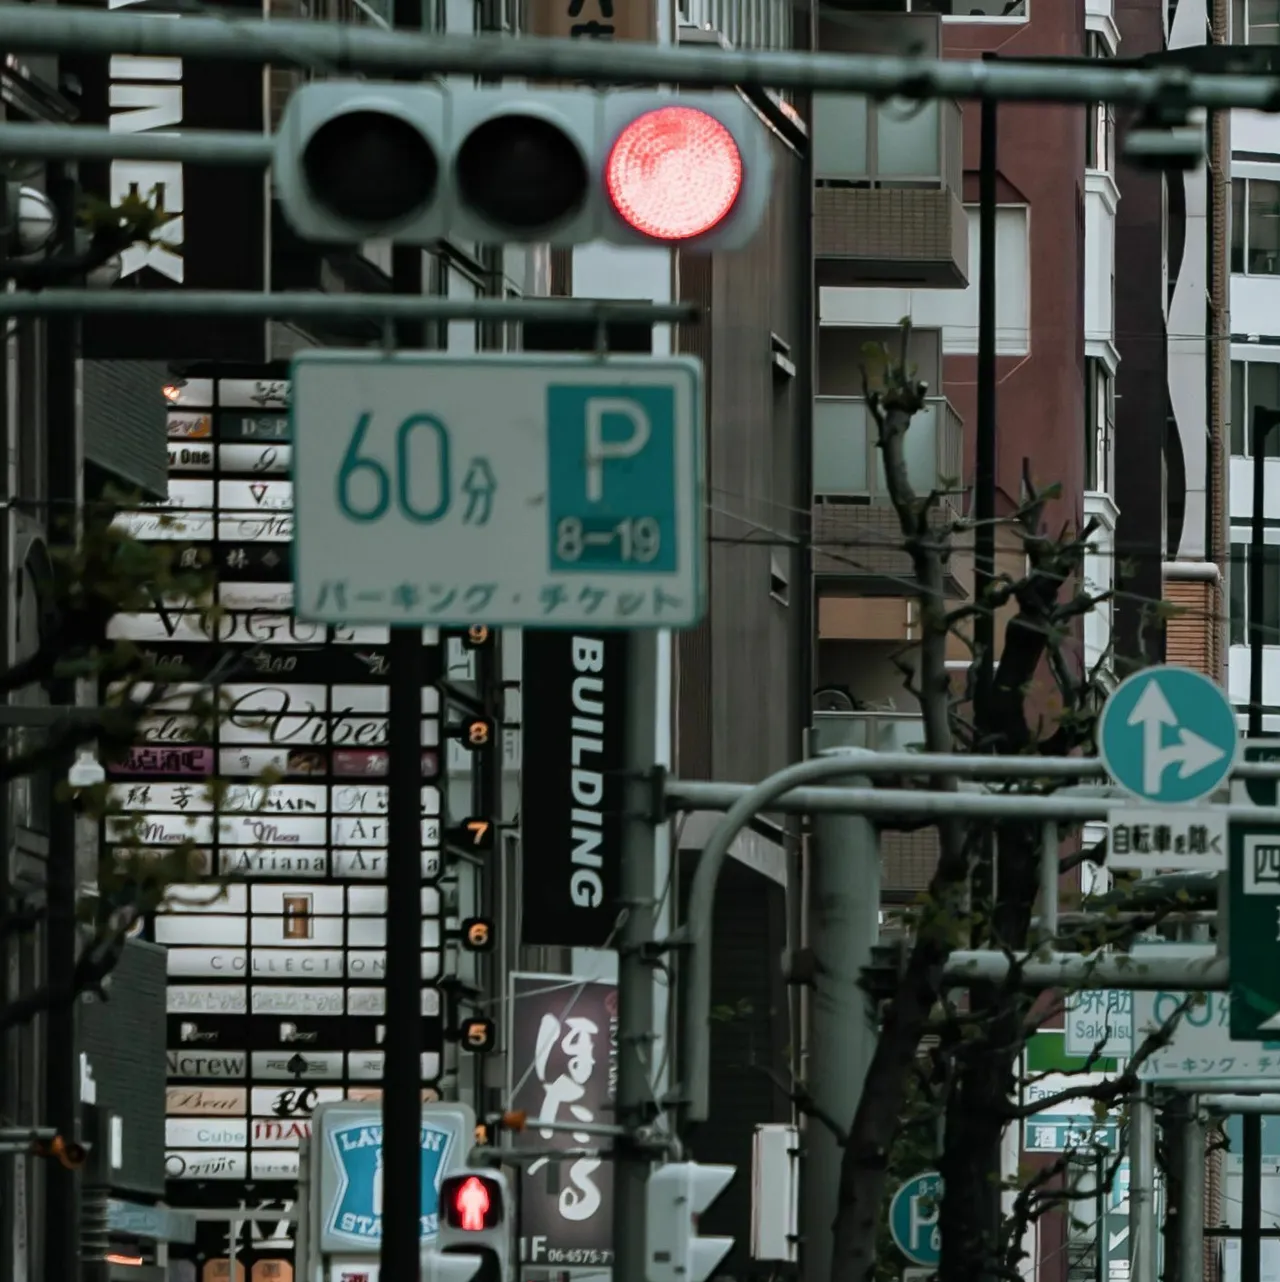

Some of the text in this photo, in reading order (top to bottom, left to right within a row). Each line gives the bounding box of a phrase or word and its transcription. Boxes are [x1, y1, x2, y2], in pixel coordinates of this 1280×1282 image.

[108, 0, 184, 284] INEX
[585, 396, 651, 503] P
[336, 411, 498, 526] 60分
[316, 581, 682, 615] パーキング・チケット
[469, 722, 488, 744] 8
[570, 636, 604, 908] BUILDING
[467, 822, 489, 845] 7
[1112, 824, 1223, 855] 自転車を除く
[237, 851, 325, 872] Ariana
[468, 923, 488, 945] 6
[210, 955, 386, 972] COLLECTION
[468, 1022, 488, 1046] 5
[198, 1129, 245, 1143] Cube
